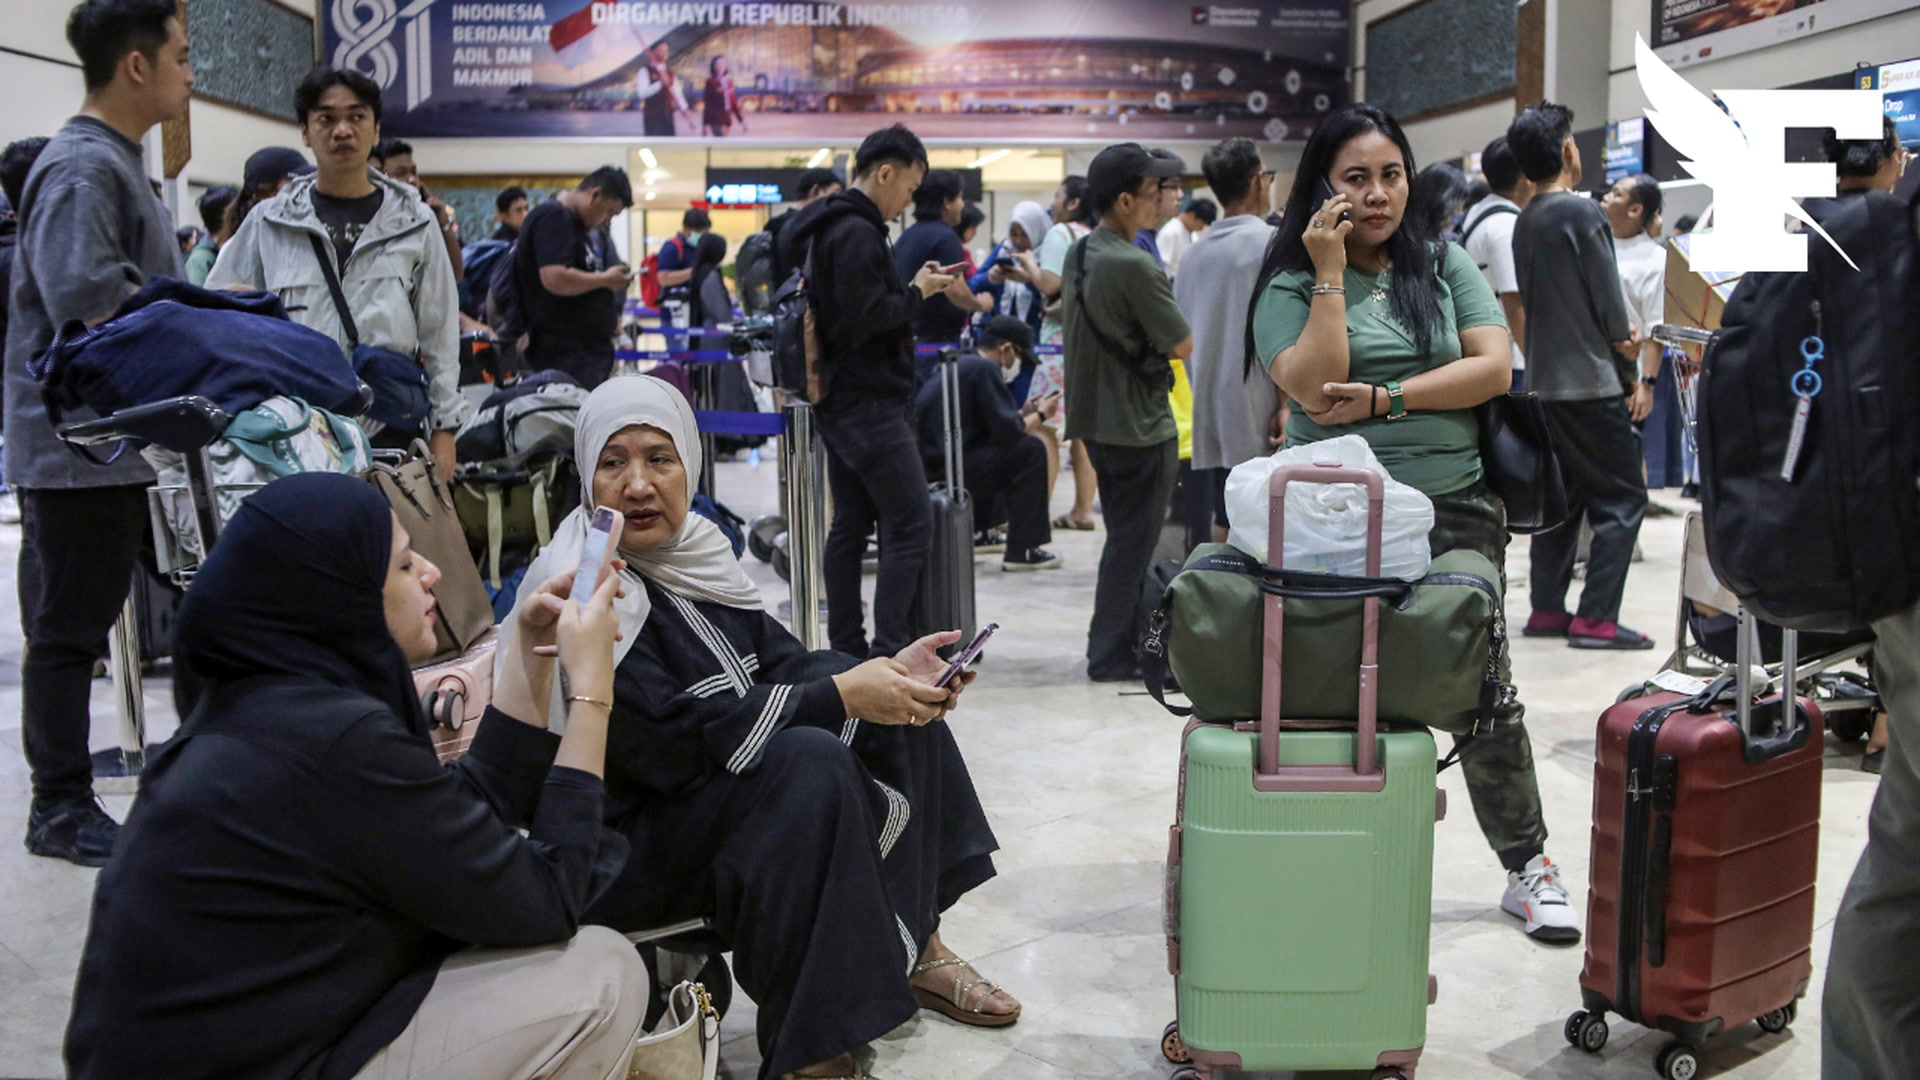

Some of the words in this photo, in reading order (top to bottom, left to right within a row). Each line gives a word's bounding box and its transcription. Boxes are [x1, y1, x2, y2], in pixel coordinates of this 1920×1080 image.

[452, 4, 546, 21] INDONESIA
[591, 3, 724, 25] DIRGAHAYU
[730, 4, 841, 25] REPUBLIK
[847, 4, 969, 26] INDONESIA
[452, 25, 553, 43] BERDAULAT
[452, 46, 492, 65] ADIL
[496, 46, 533, 65] DAN
[453, 68, 533, 86] MAKMUR
[1885, 99, 1904, 114] Drop
